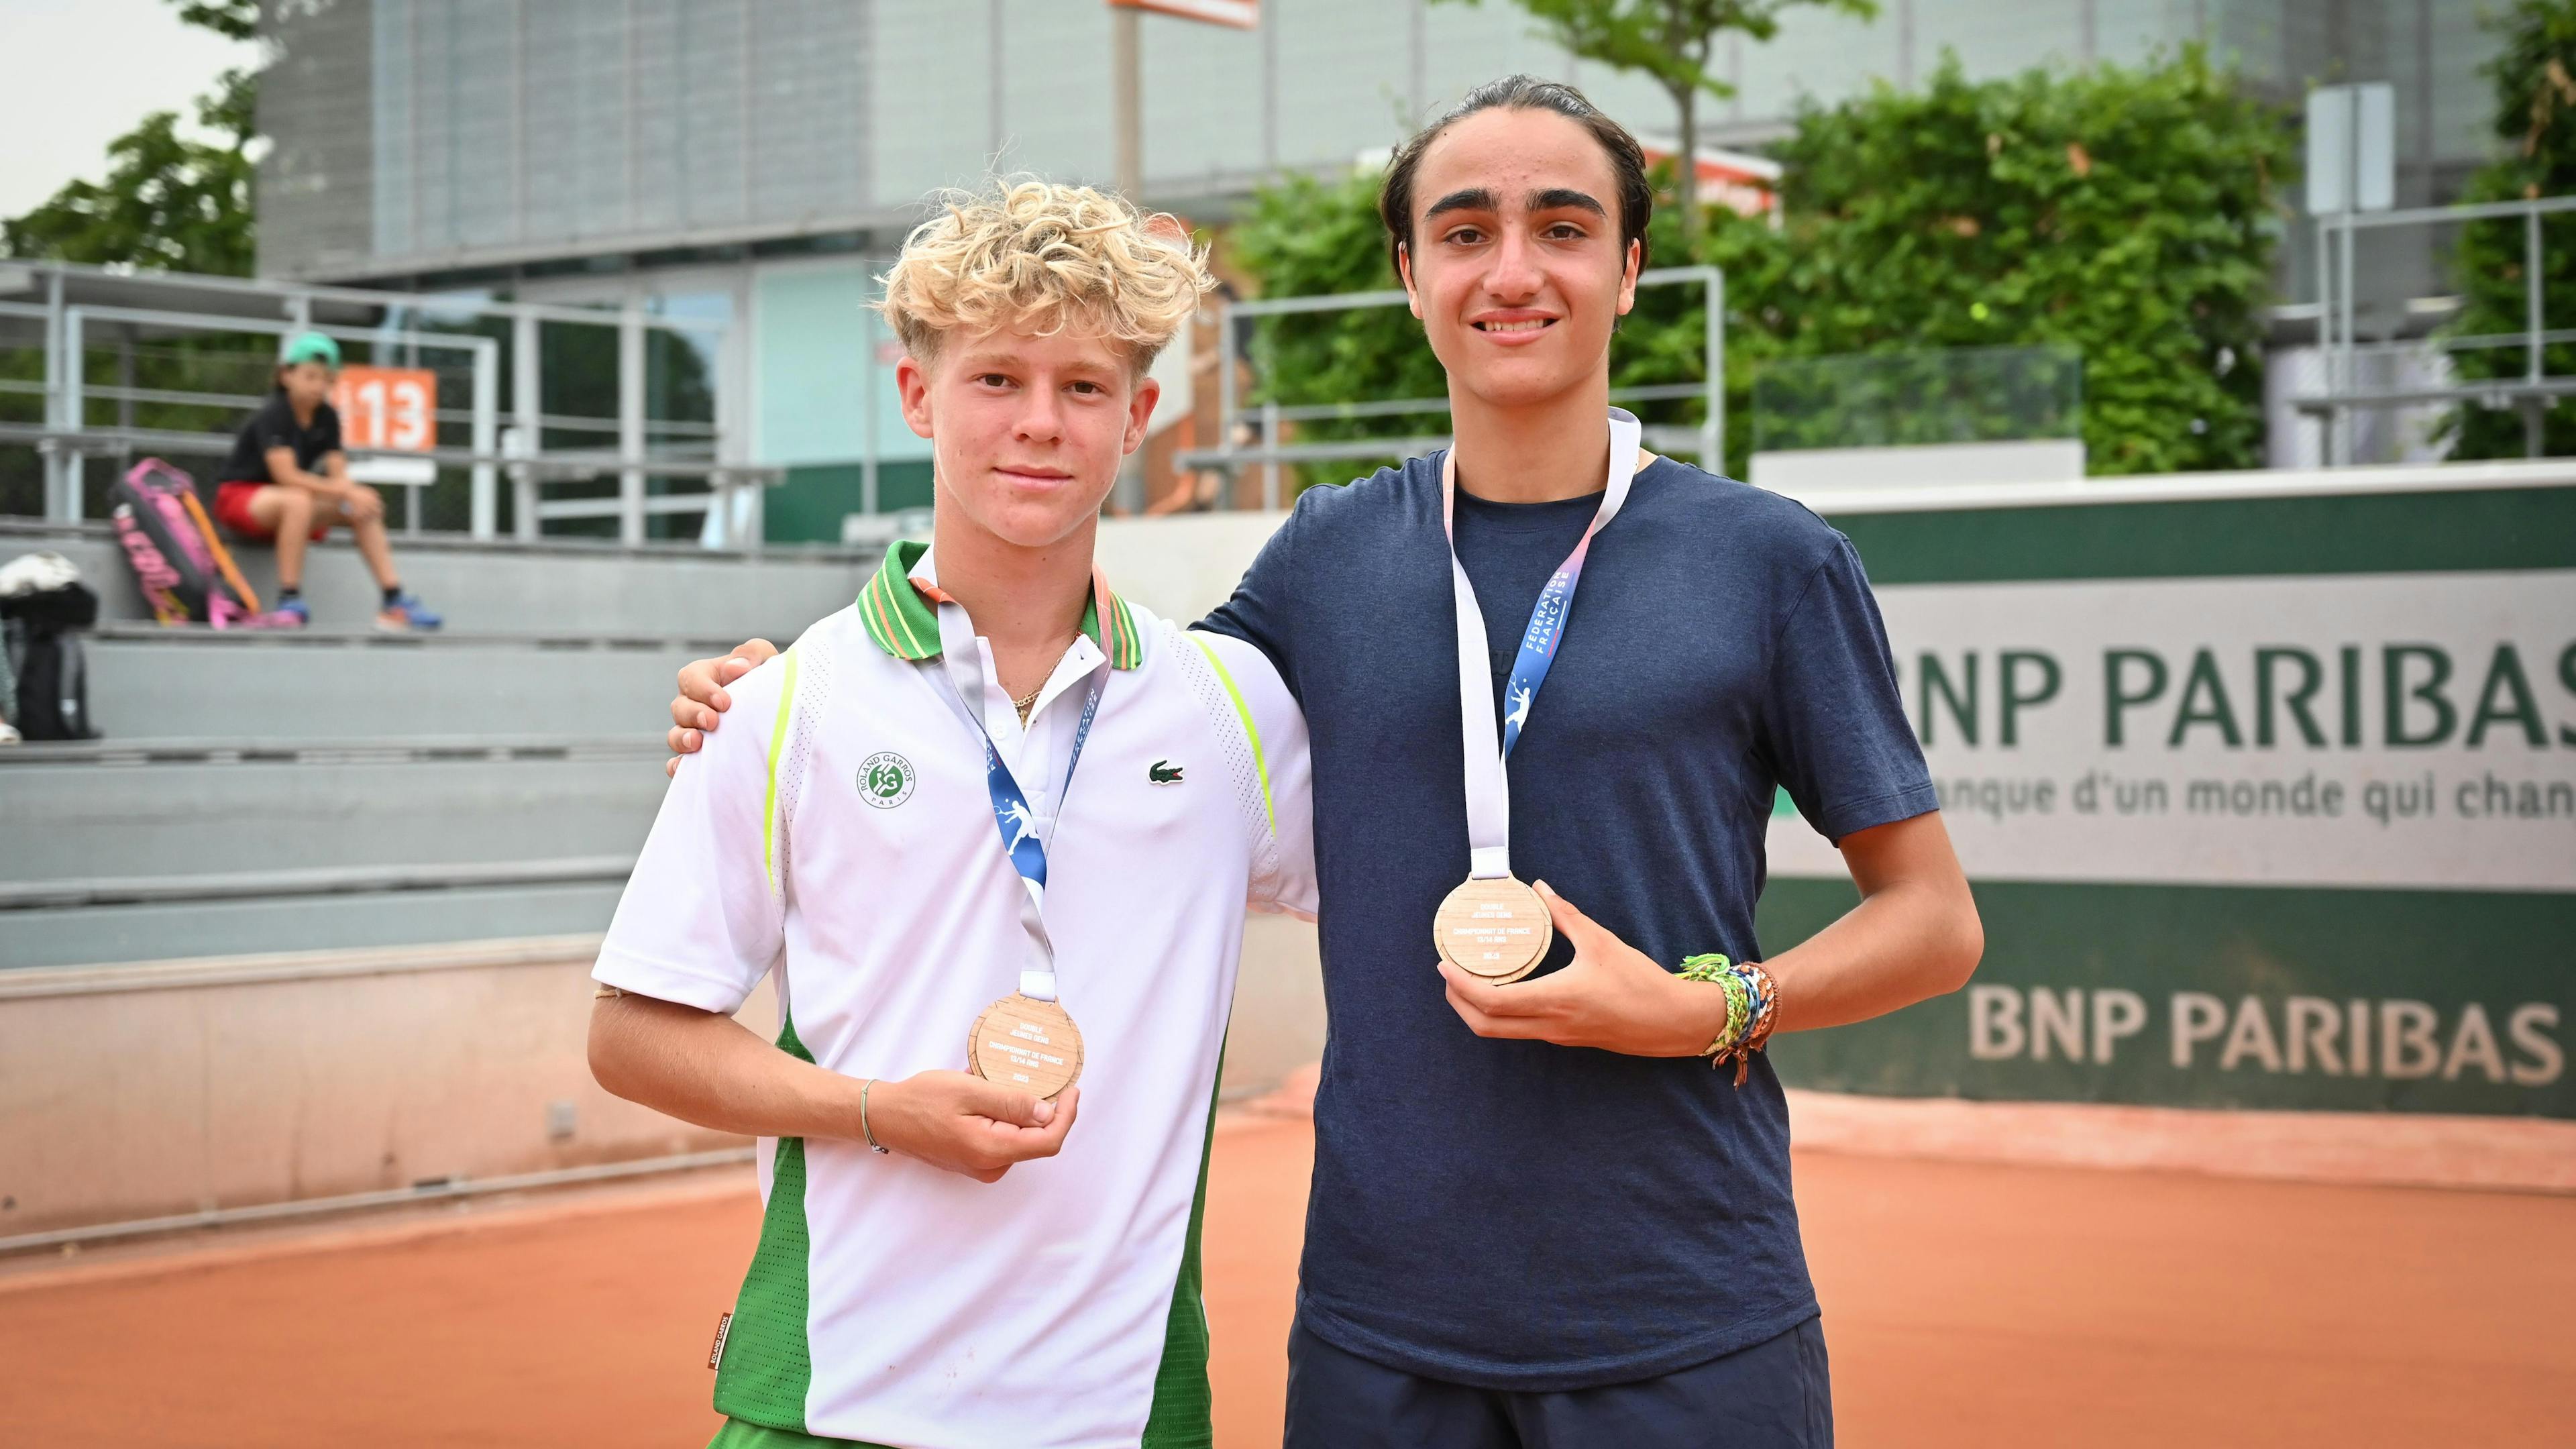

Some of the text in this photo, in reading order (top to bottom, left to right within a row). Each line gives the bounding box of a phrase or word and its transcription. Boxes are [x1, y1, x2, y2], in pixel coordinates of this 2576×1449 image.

[358, 380, 426, 449] 13
[1526, 572, 1561, 650] FÉDÉRATION
[1536, 572, 1569, 654] FRANÇAISE
[1897, 642, 2576, 747] NP PARIBA
[859, 755, 912, 792] ROLAND GARROS
[871, 791, 907, 806] PARIS
[2074, 769, 2169, 814] d'un
[2186, 769, 2344, 817] monde
[2363, 771, 2436, 827] qui
[989, 1041, 1063, 1065] CHAMPIONNAT DE FRANCE
[1020, 1022, 1043, 1034] DOUBLE
[1969, 984, 2564, 1087] BNP PARIBAS
[710, 1316, 729, 1364] ROLAND GARROS
